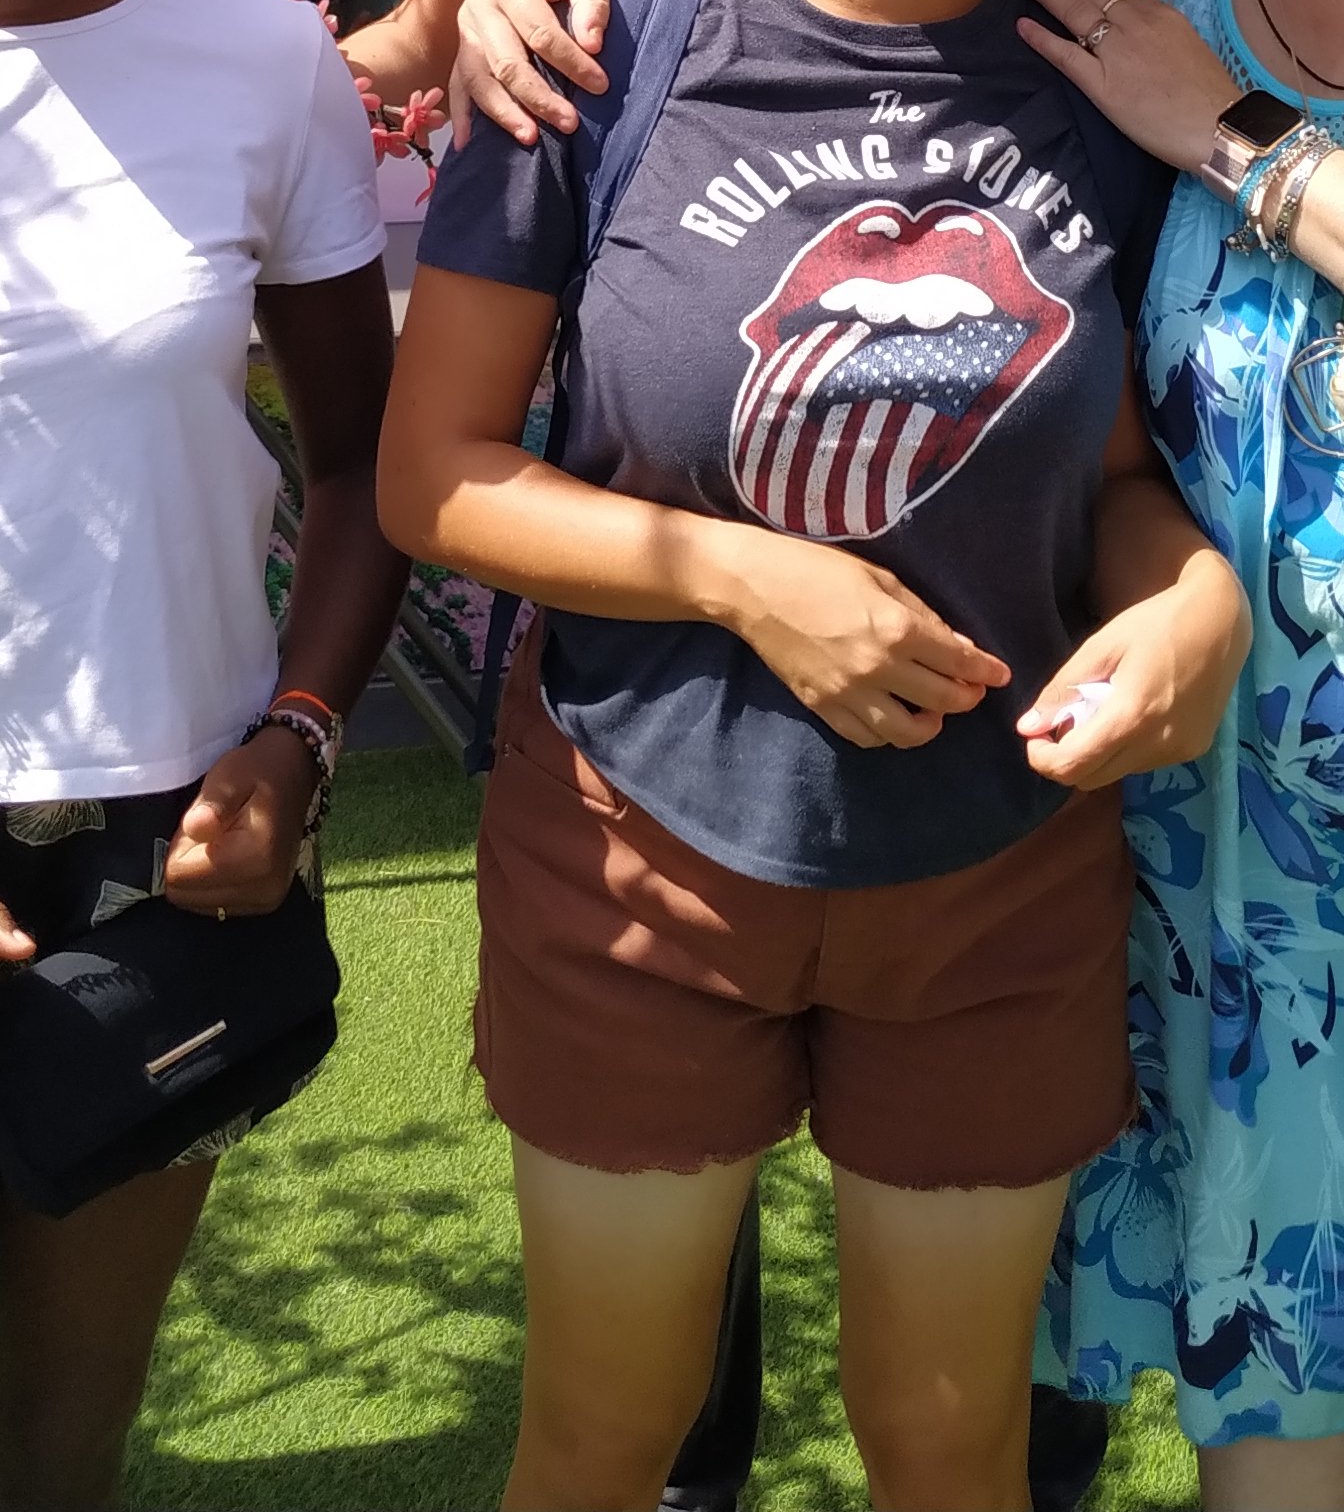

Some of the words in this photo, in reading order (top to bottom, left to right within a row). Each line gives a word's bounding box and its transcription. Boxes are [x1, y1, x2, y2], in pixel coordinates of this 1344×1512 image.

[868, 89, 927, 125] The
[679, 133, 894, 249] ROLLING
[921, 135, 1096, 255] STONES
